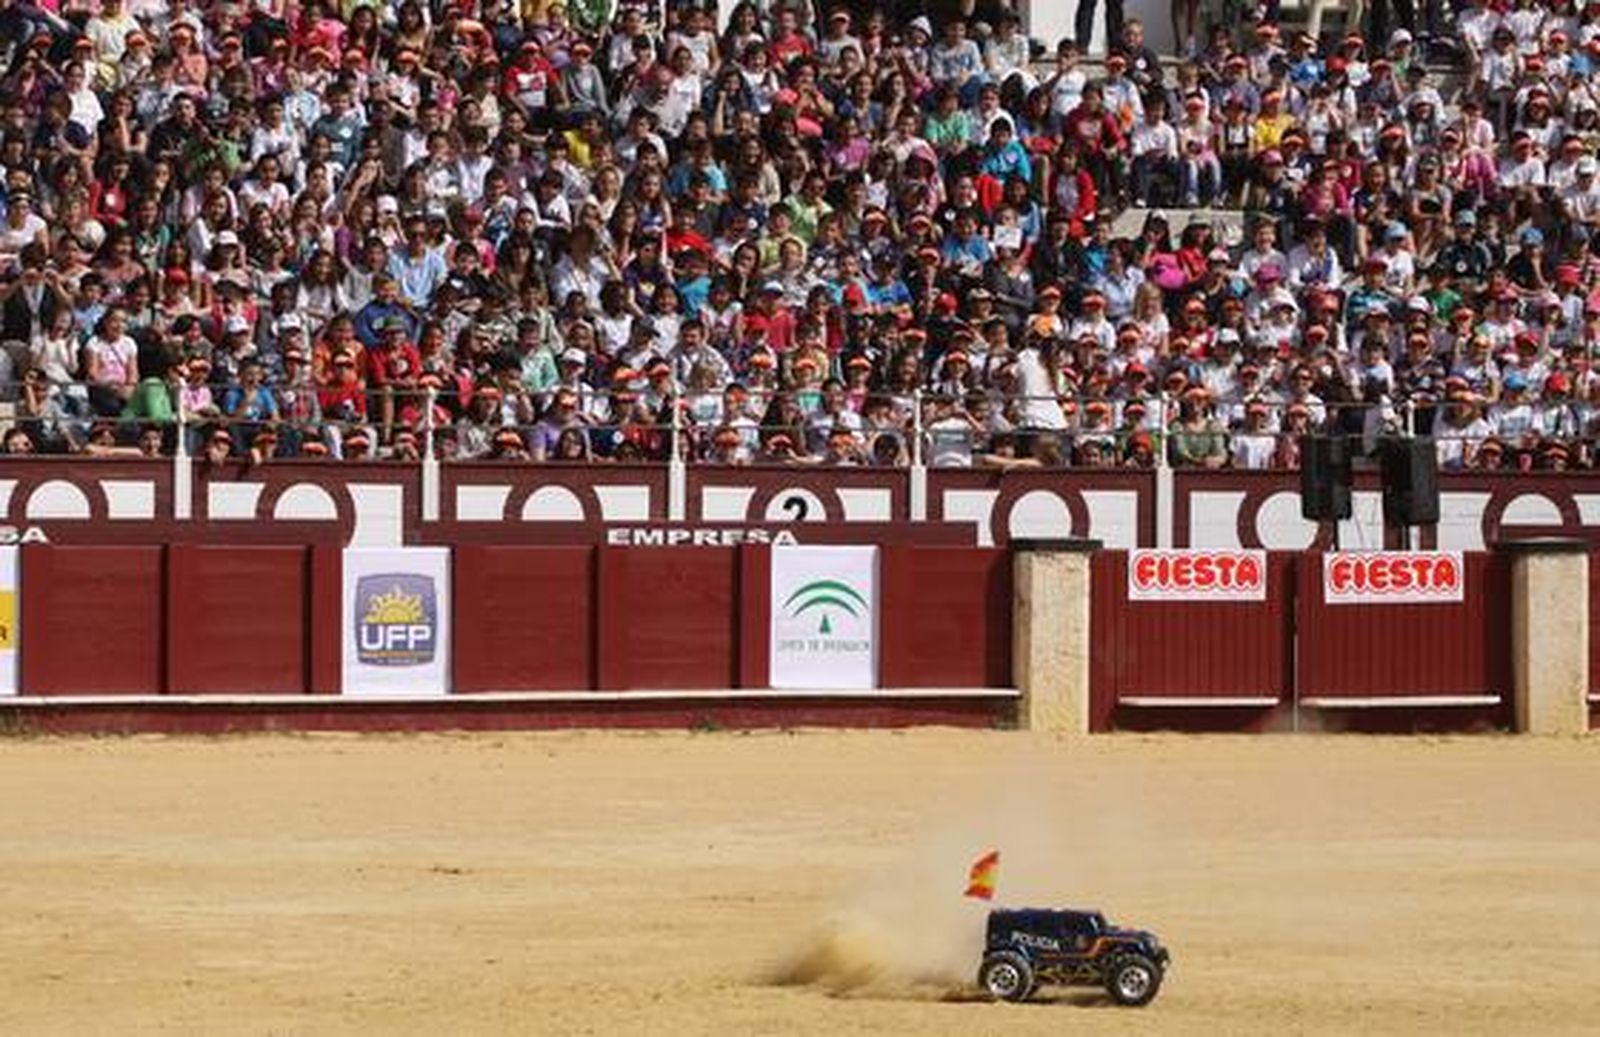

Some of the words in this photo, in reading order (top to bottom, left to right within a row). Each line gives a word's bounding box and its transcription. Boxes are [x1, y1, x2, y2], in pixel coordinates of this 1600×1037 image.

[607, 528, 798, 546] EMPRESA
[1135, 555, 1260, 588] FIESTA
[1331, 556, 1457, 590] FIESTA
[360, 624, 431, 650] UFP
